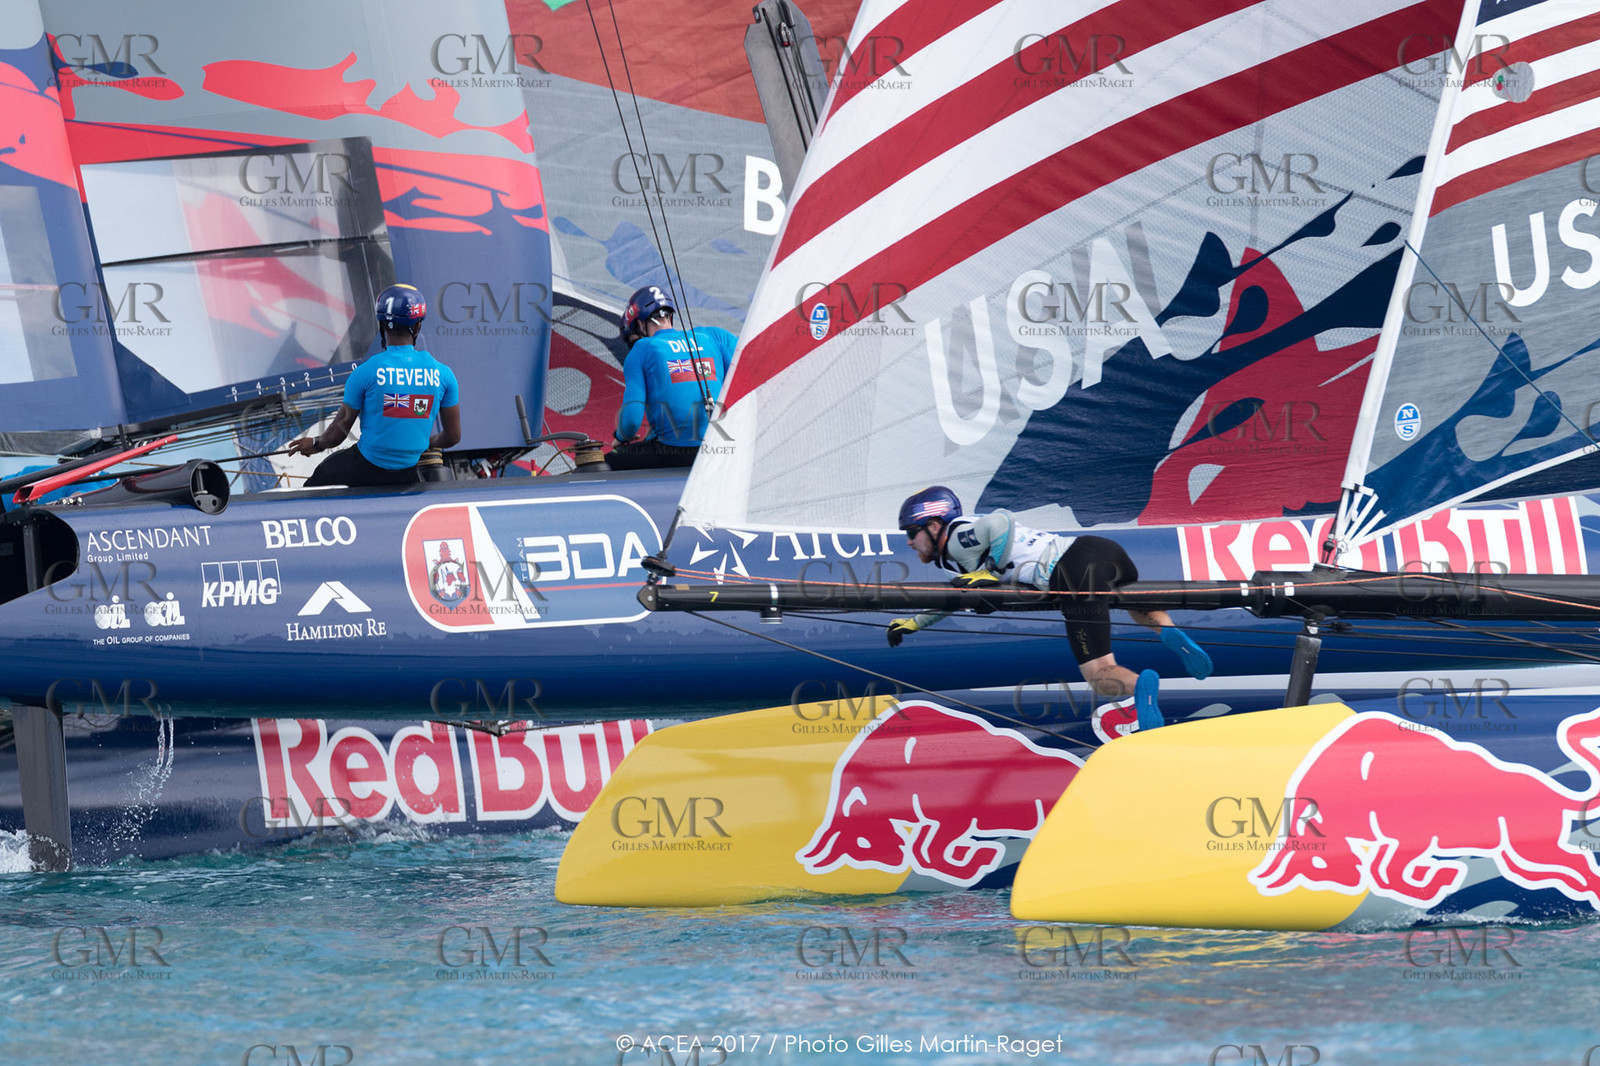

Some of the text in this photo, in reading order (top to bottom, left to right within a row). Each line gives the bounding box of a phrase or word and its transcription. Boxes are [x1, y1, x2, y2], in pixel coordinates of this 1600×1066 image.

[744, 155, 786, 235] B
[1491, 198, 1600, 307] US
[924, 236, 1173, 446] USA
[304, 372, 310, 380] 2
[376, 367, 440, 387] STEVENS
[87, 526, 211, 552] ASCENDANT
[261, 516, 357, 549] BELCO
[1394, 497, 1587, 576] Bull
[87, 552, 149, 563] Group Limited
[516, 537, 528, 582] TEAM
[523, 532, 652, 582] BDA
[202, 578, 277, 608] KPMG
[709, 591, 719, 602] 7
[122, 636, 143, 644] GROUP
[155, 633, 190, 642] COMPANIES
[286, 619, 387, 641] HAMILTON RE
[253, 718, 653, 826] Red Bul
